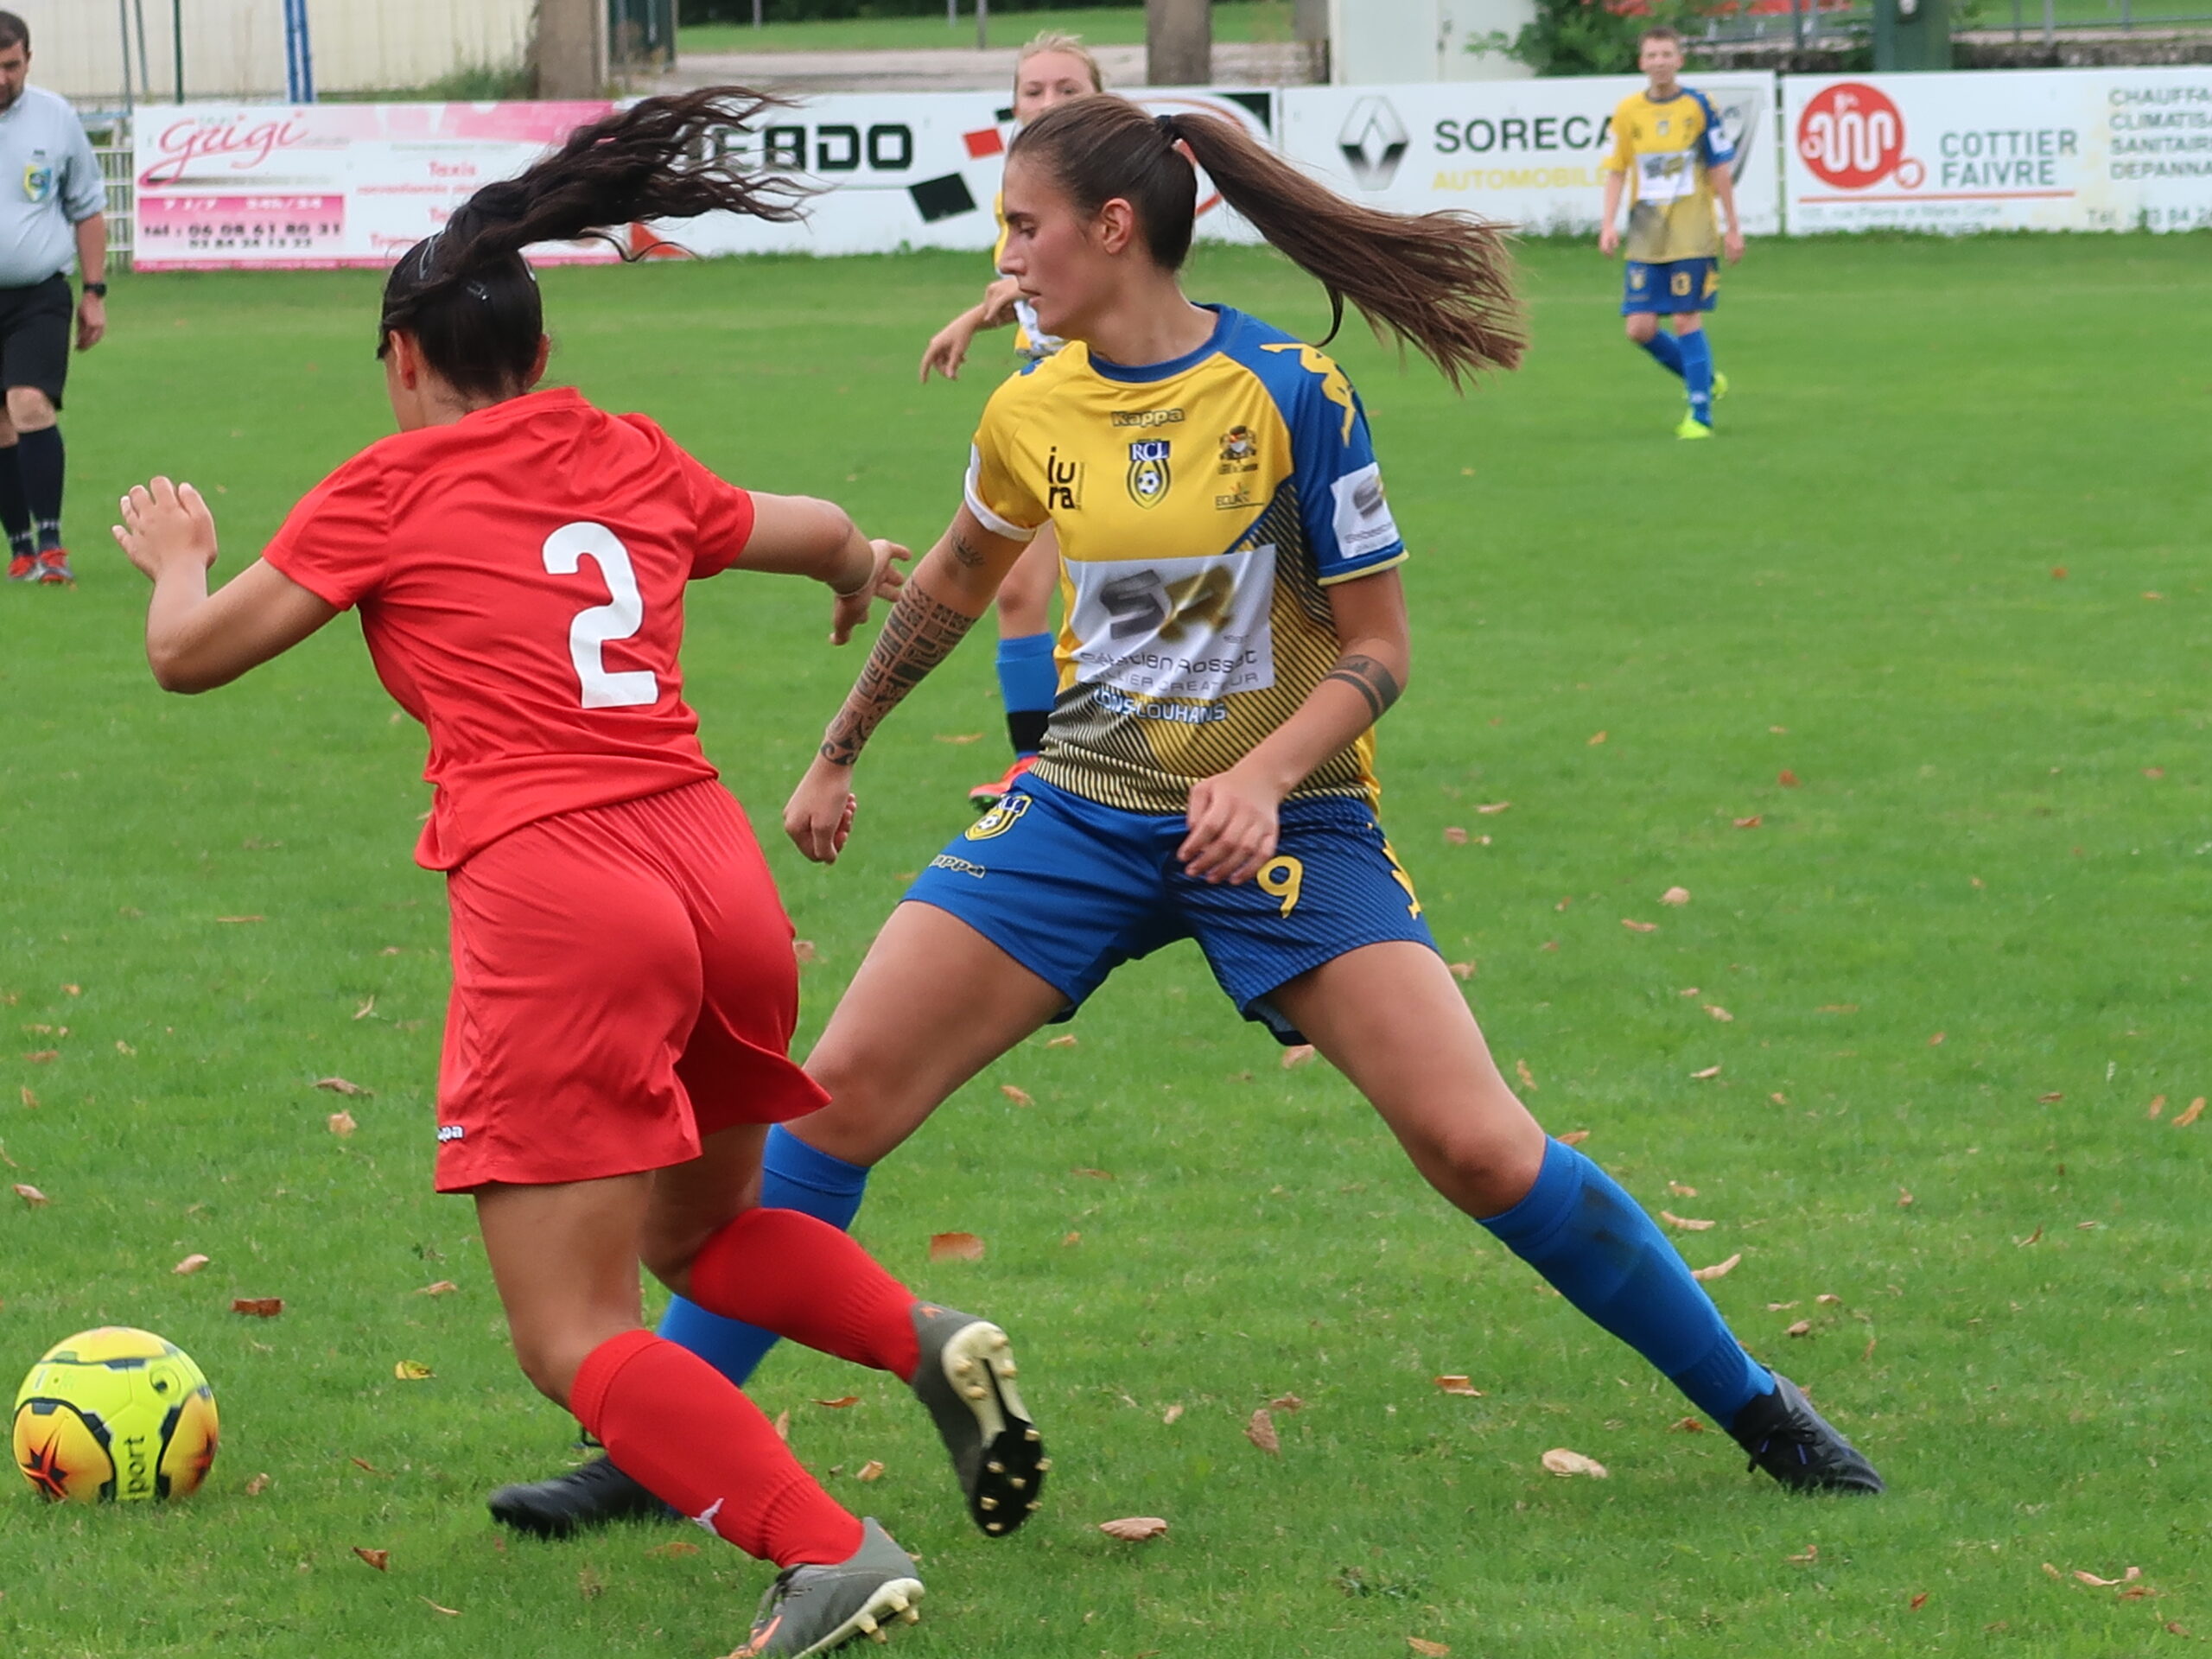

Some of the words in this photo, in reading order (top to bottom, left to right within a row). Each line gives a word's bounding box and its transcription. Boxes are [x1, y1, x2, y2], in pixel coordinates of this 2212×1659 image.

[2108, 112, 2212, 130] CLIMATIS
[689, 124, 912, 169] EBDO
[1941, 130, 2077, 156] COTTIER
[2109, 136, 2212, 156] SANITAIR
[1942, 160, 2055, 187] FAIVRE
[1111, 408, 1185, 428] Kappa
[1132, 442, 1168, 461] RCL
[542, 522, 658, 709] 2
[1256, 855, 1303, 919] 9
